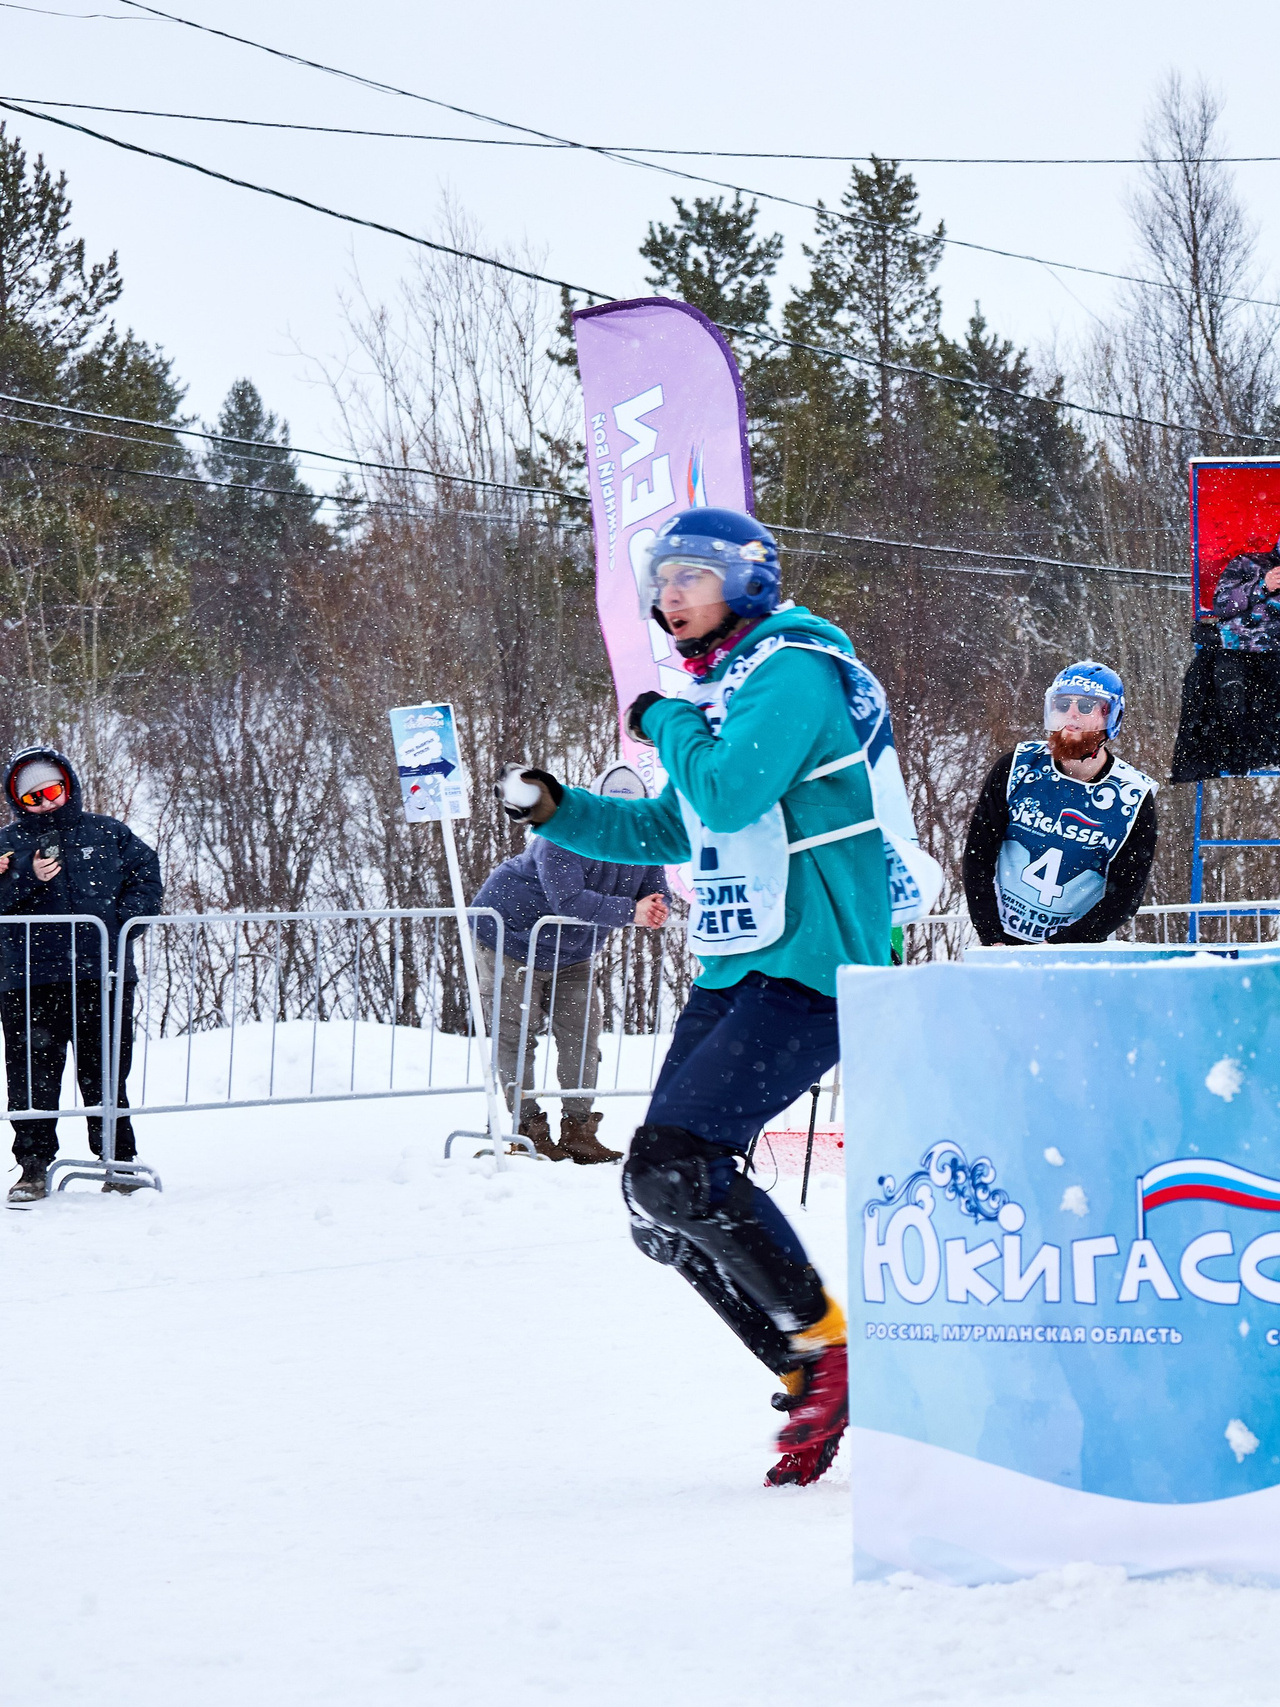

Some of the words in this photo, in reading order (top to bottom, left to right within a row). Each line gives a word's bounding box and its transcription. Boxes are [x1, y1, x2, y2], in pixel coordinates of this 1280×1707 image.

[1021, 847, 1064, 908] 4
[866, 1322, 939, 1344] РОССИЯ,
[942, 1324, 1086, 1344] МУРМАНСКАЯ
[1090, 1326, 1183, 1345] ОБЛАСТЬ
